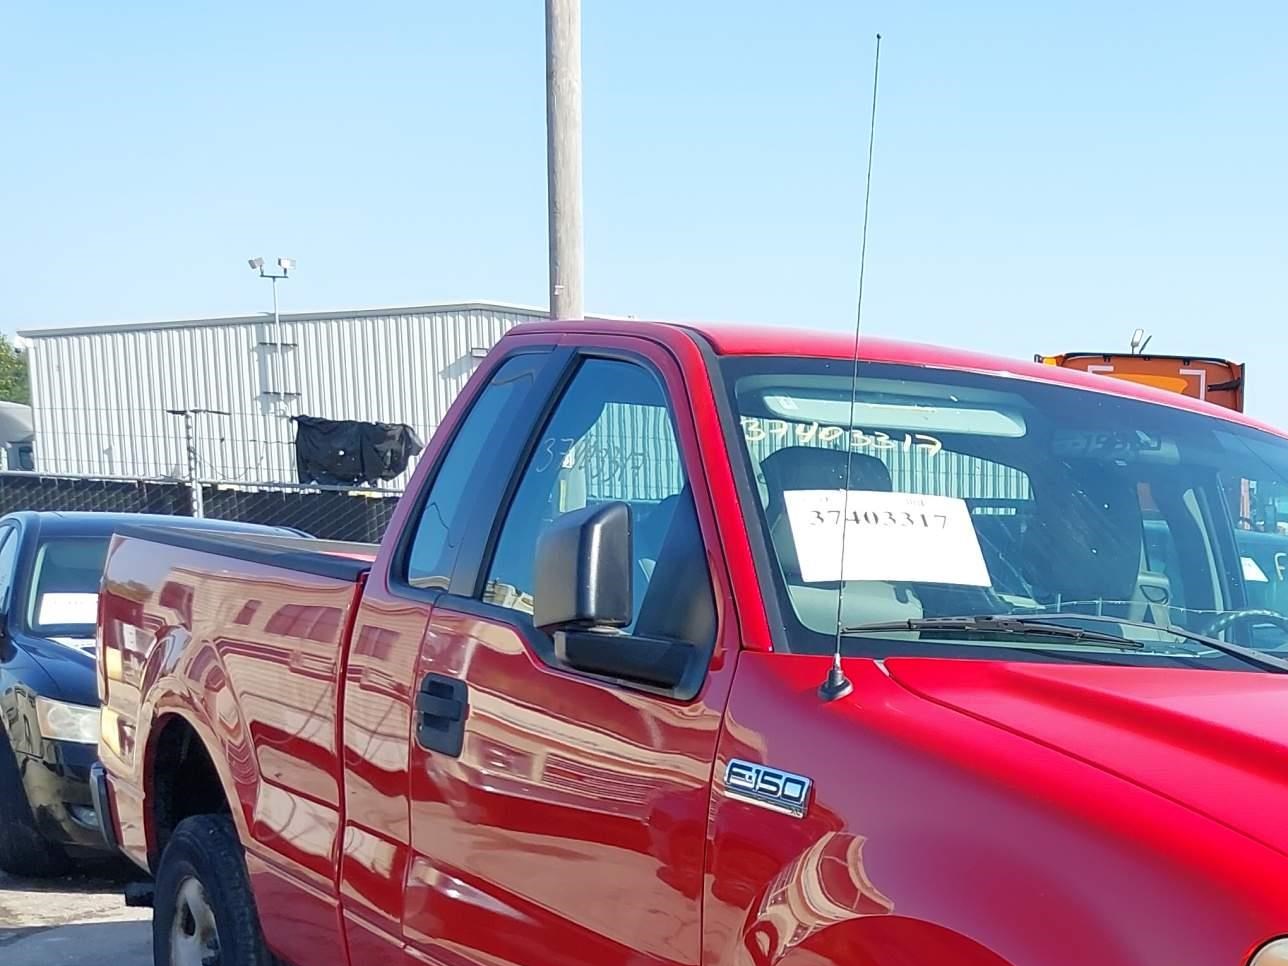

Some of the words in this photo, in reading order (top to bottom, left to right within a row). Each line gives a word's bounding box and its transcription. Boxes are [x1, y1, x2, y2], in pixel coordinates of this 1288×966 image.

[740, 415, 943, 454] 37403317
[810, 509, 948, 529] 37403317
[725, 760, 808, 805] F-150
